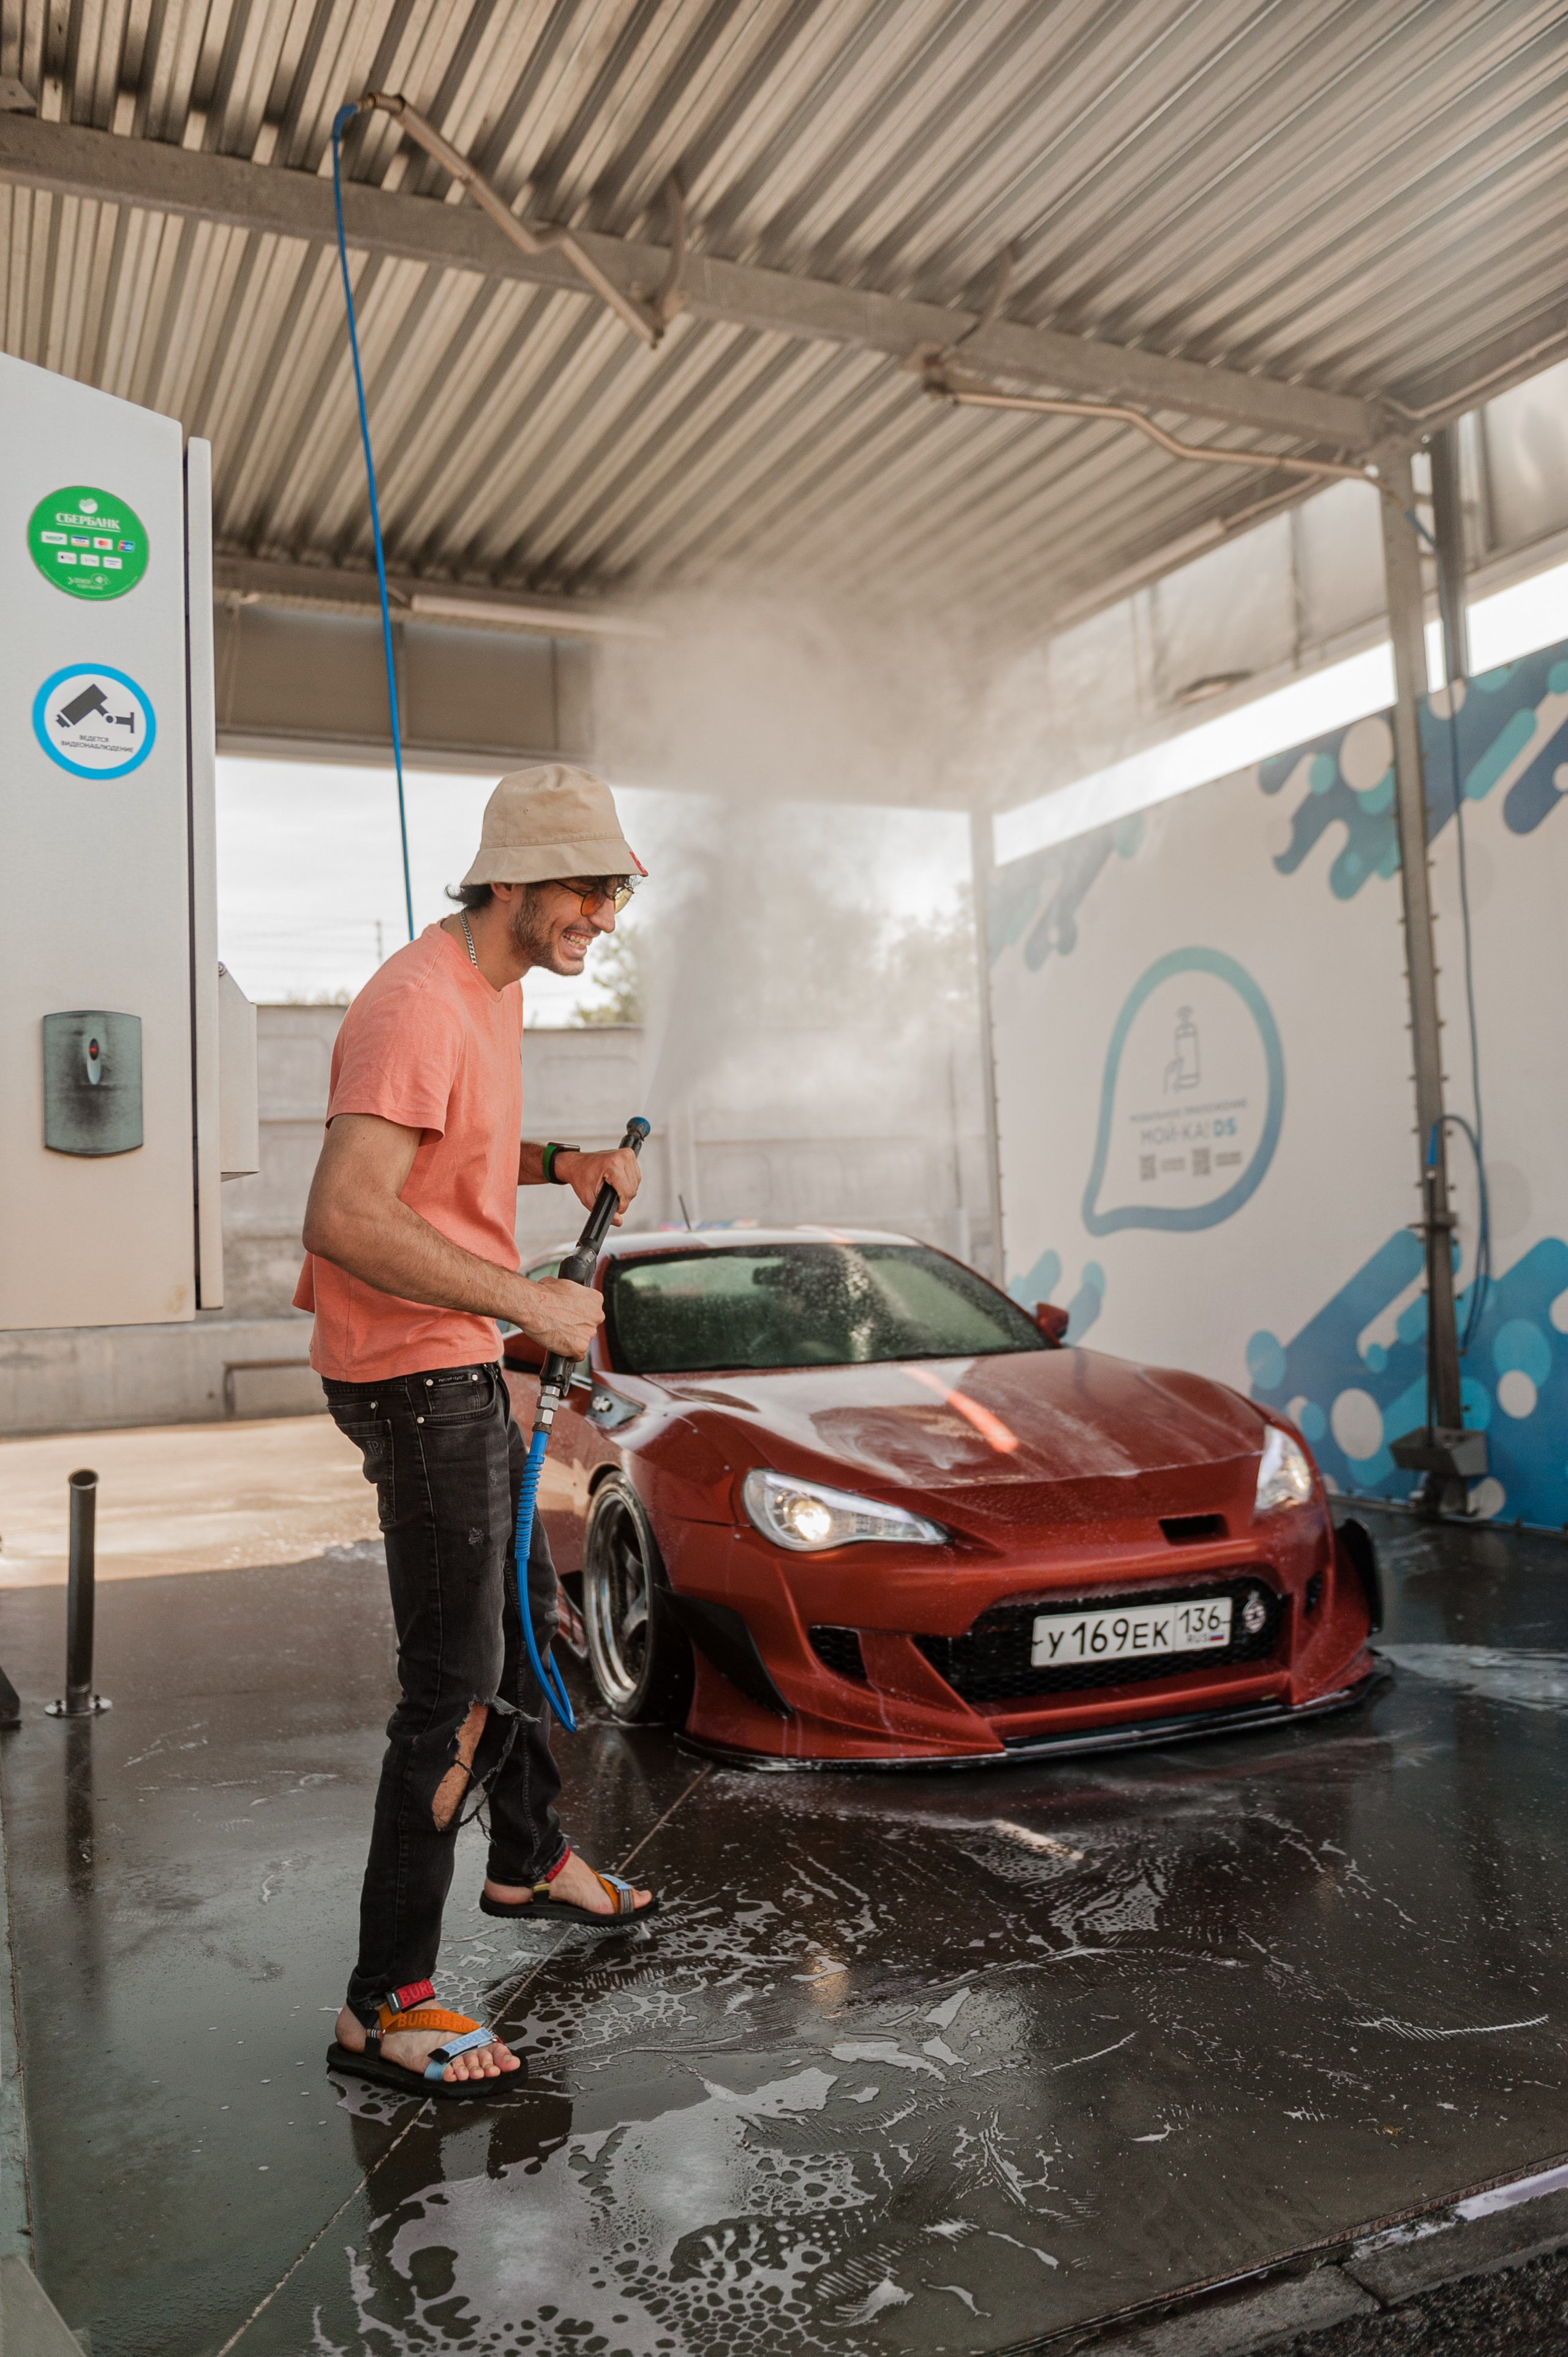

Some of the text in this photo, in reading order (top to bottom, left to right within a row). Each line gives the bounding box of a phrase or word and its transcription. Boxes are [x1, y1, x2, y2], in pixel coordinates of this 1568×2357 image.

[56, 513, 121, 530] СБЕРБАНК
[61, 740, 134, 752] ВИДЕОНАБЛЮДЕНИЕ
[1179, 1605, 1220, 1633] 136
